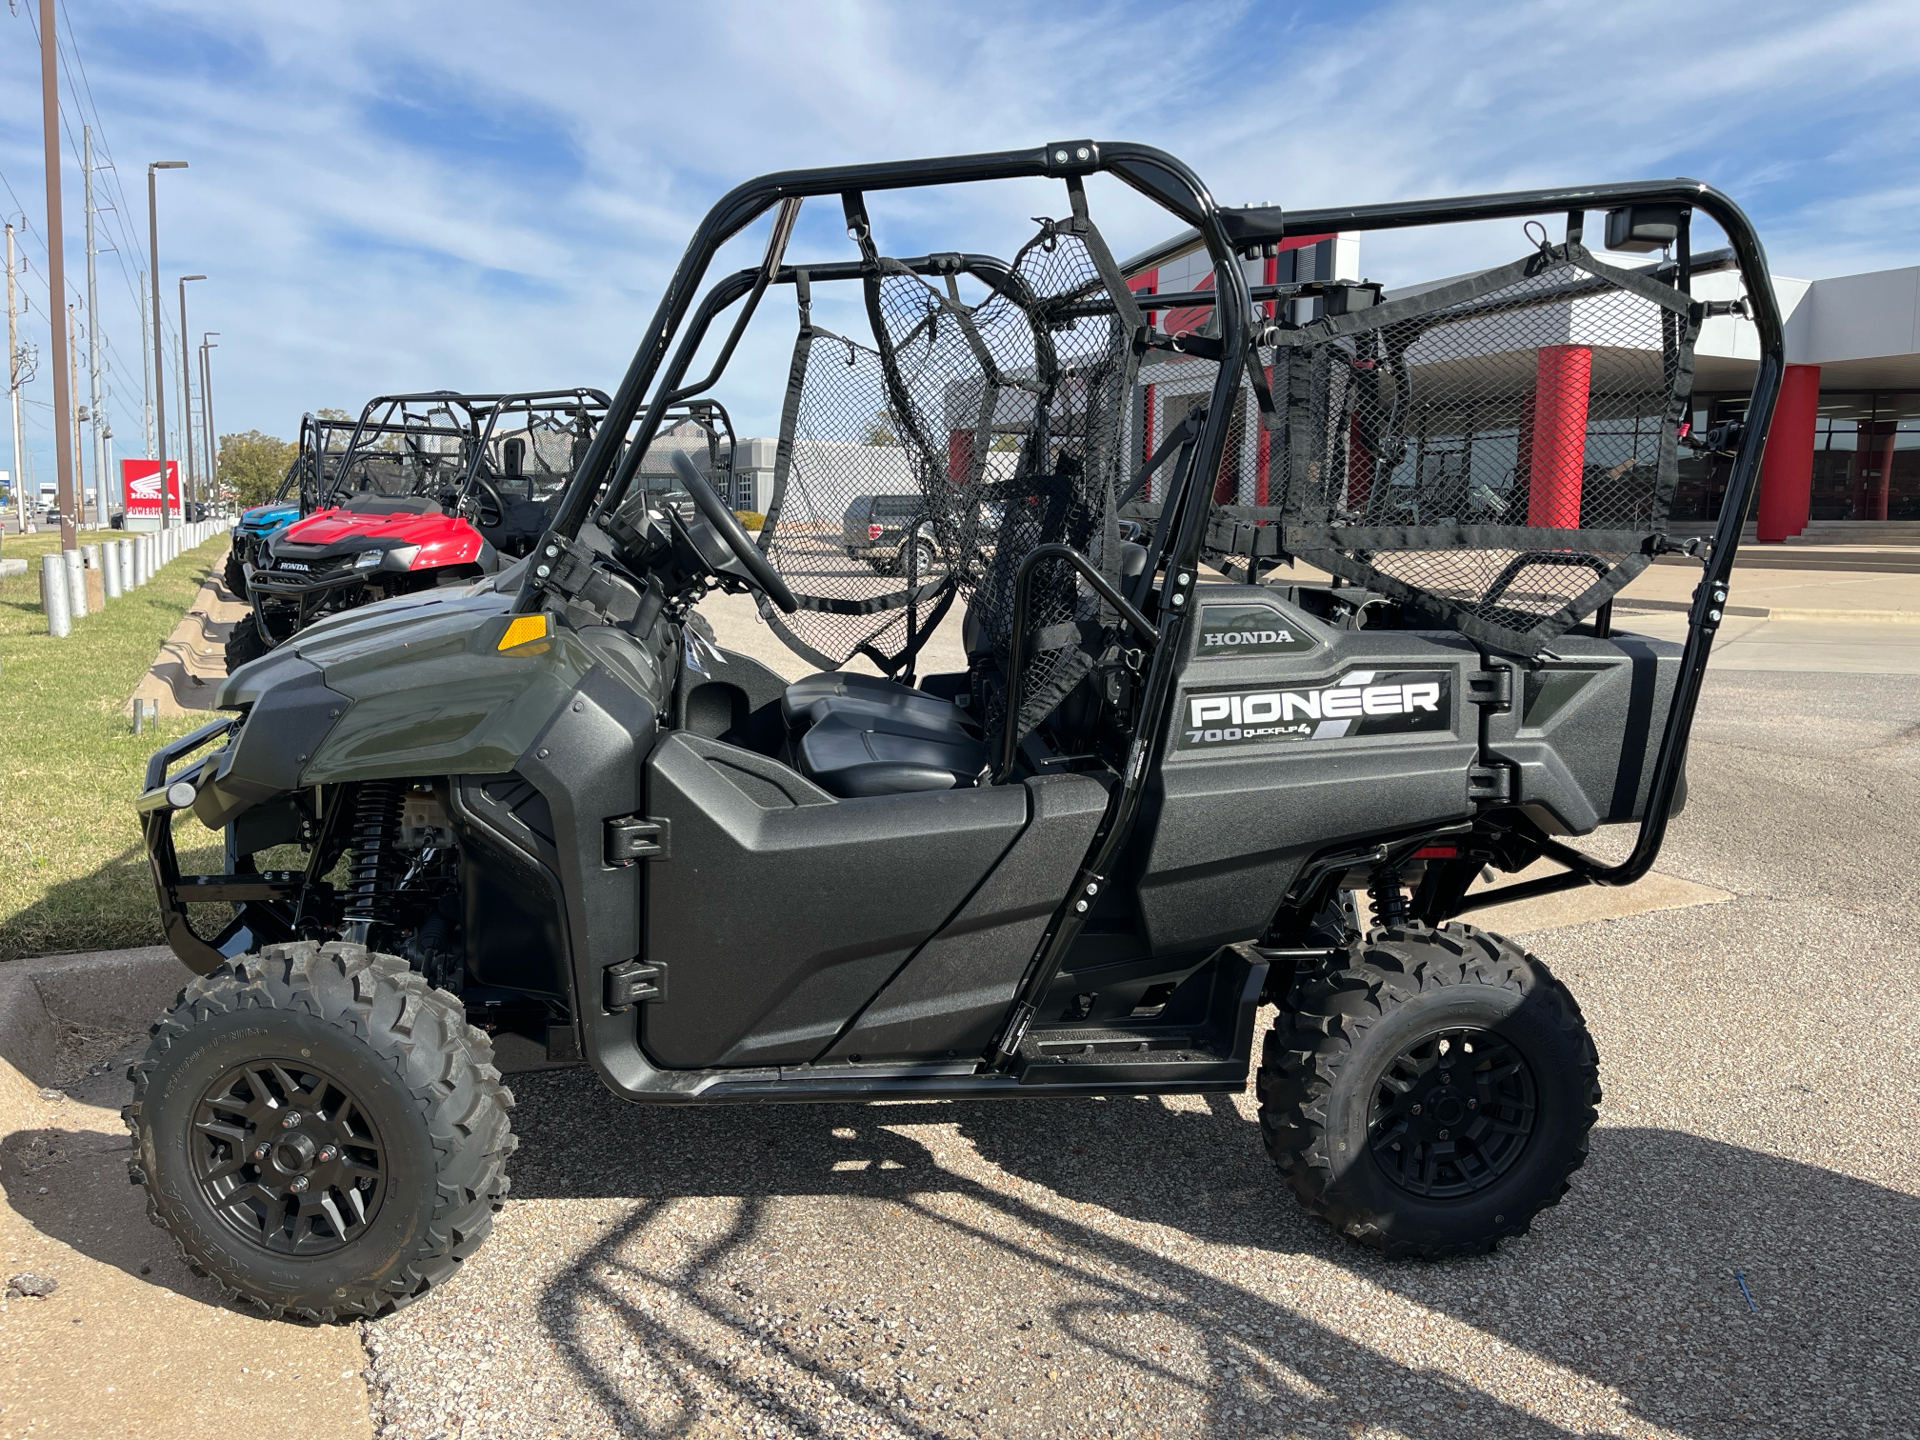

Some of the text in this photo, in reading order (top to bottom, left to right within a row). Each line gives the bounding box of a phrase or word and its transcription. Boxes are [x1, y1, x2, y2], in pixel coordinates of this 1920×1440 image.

[280, 562, 310, 572] HONDA
[1204, 630, 1294, 647] HONDA
[1191, 682, 1440, 727] PIONEER
[1185, 728, 1242, 743] 700
